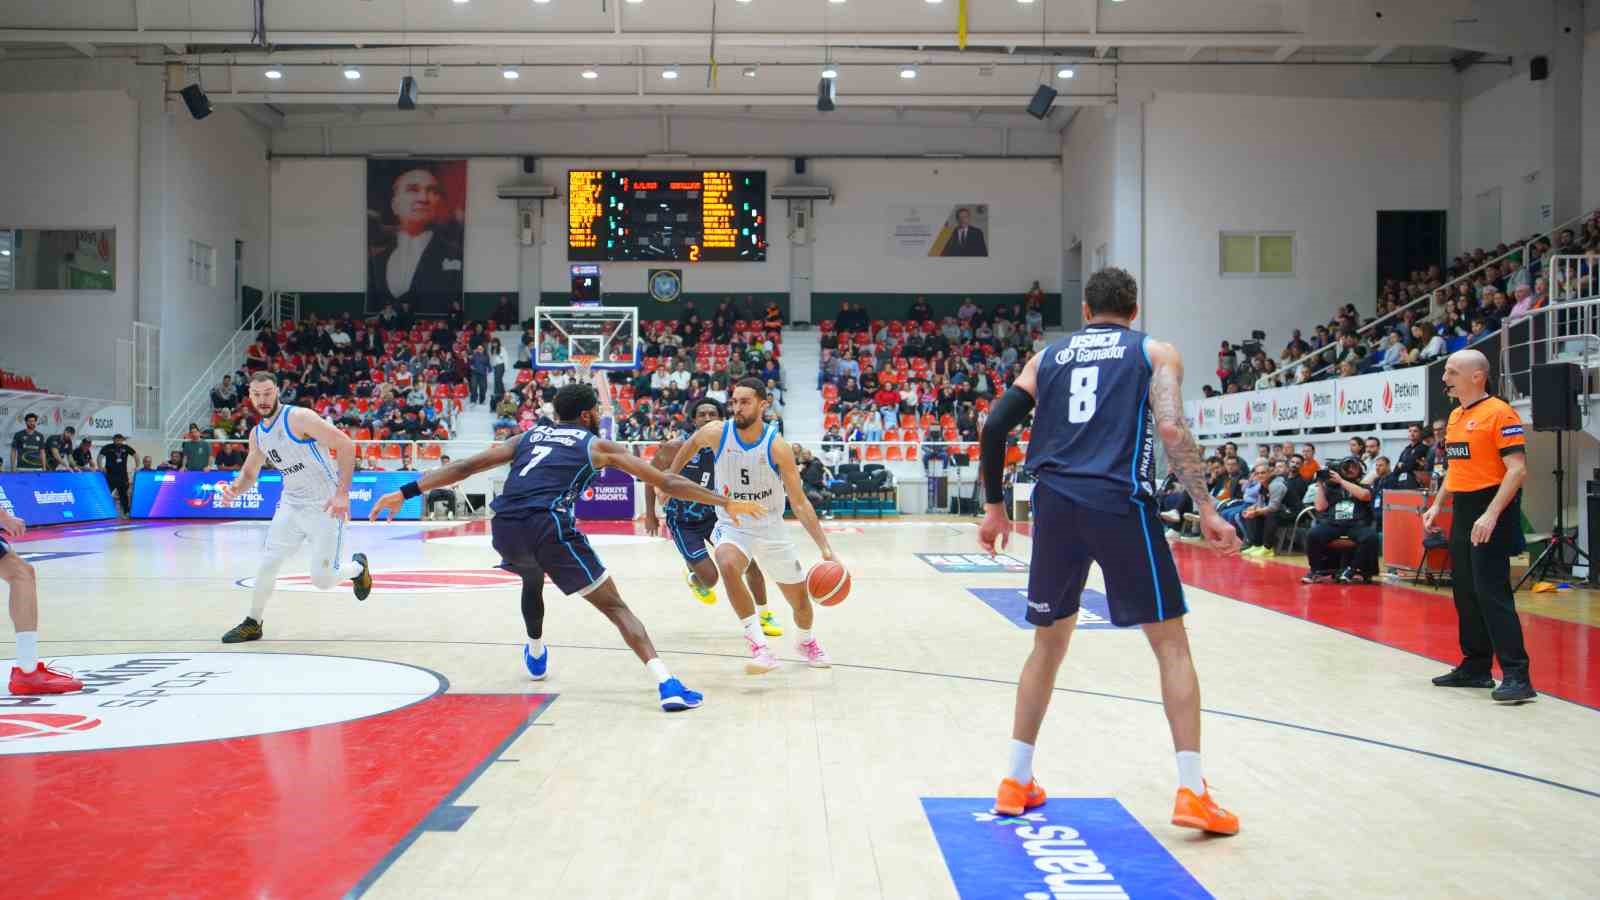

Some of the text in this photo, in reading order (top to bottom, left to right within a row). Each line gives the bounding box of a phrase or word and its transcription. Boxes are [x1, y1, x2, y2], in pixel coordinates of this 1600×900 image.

[1068, 366, 1099, 424] 8
[1394, 383, 1420, 398] Petkim
[1346, 398, 1373, 415] SOCAR
[268, 449, 282, 463] 19
[519, 445, 553, 477] 7
[700, 471, 711, 488] 9
[740, 468, 750, 486] 5
[733, 488, 773, 501] PETKIM
